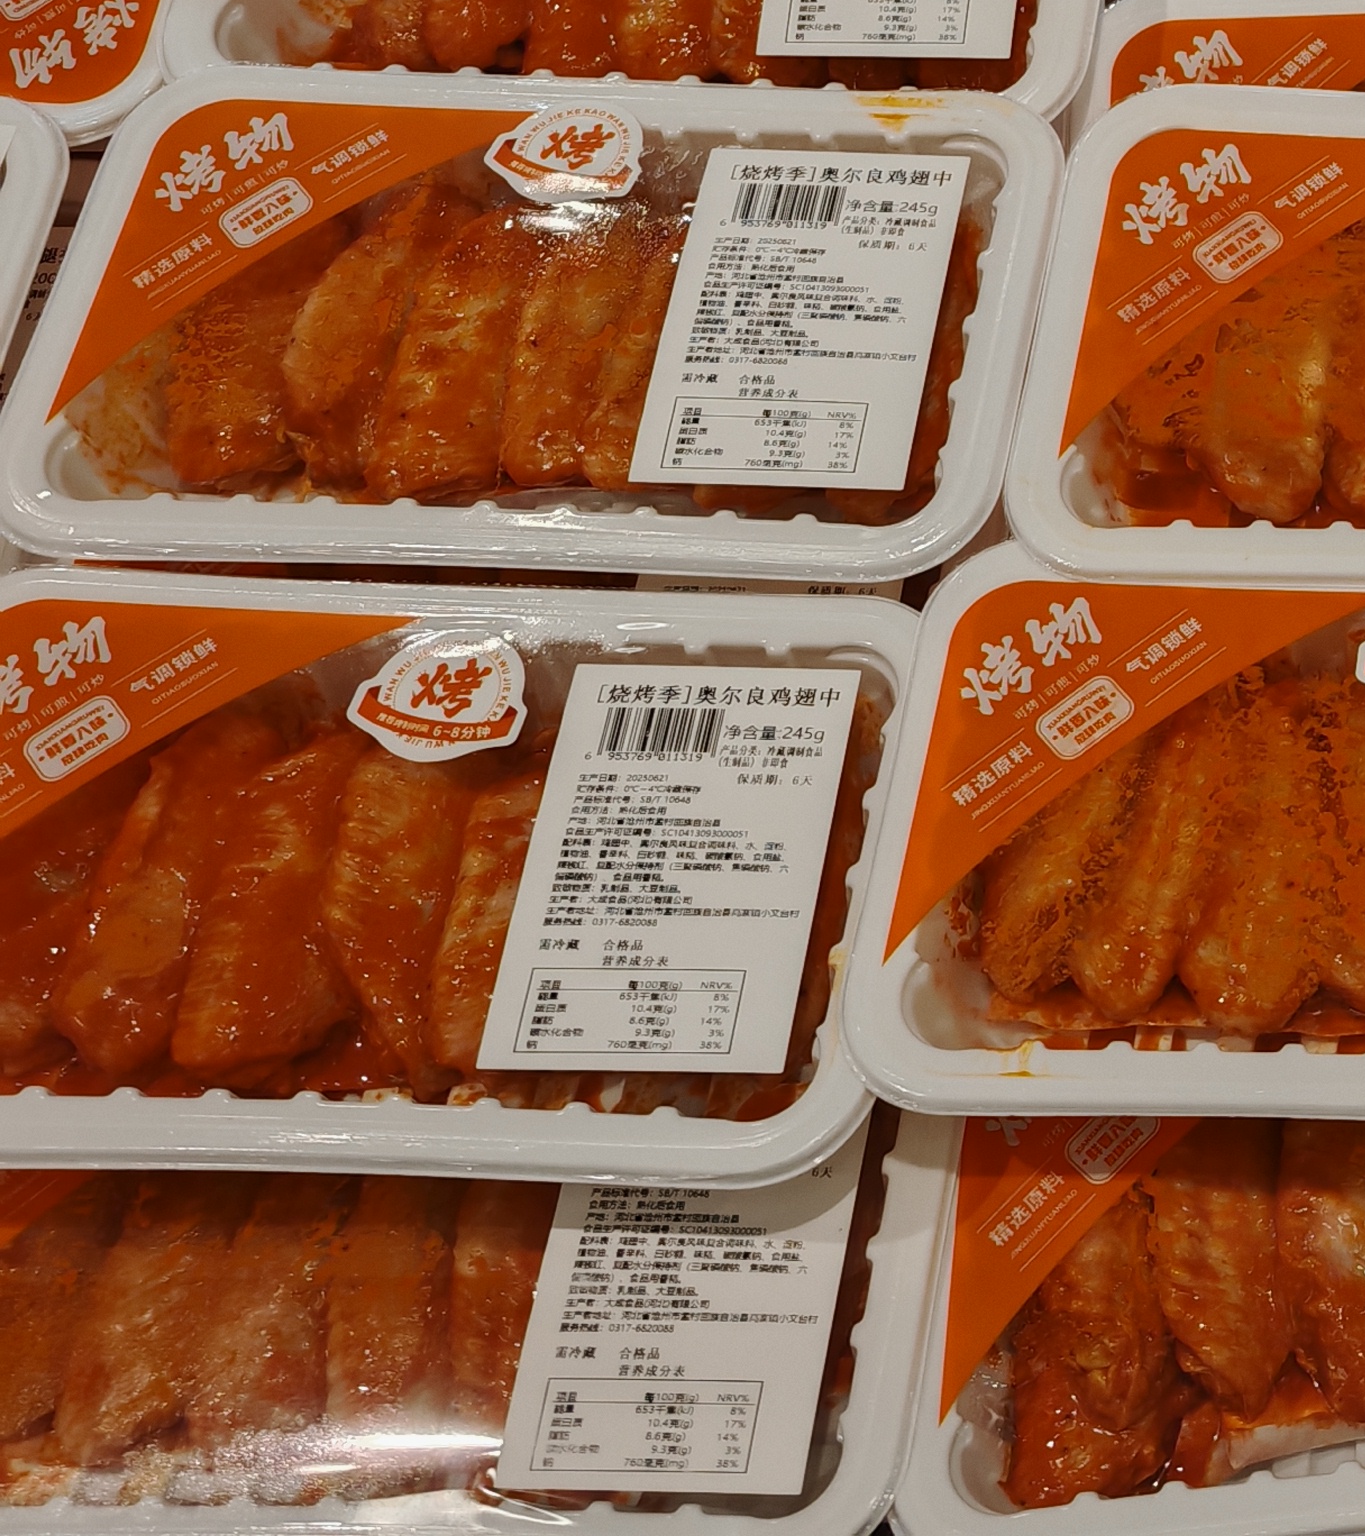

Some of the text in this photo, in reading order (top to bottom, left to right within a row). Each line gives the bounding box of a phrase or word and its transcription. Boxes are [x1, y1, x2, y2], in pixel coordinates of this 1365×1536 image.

[132, 233, 212, 287] 精选原料
[1117, 268, 1190, 322] 精选原料
[410, 657, 493, 718] 烤
[952, 742, 1032, 806] 精选原料
[989, 1171, 1064, 1246] 精选原料
